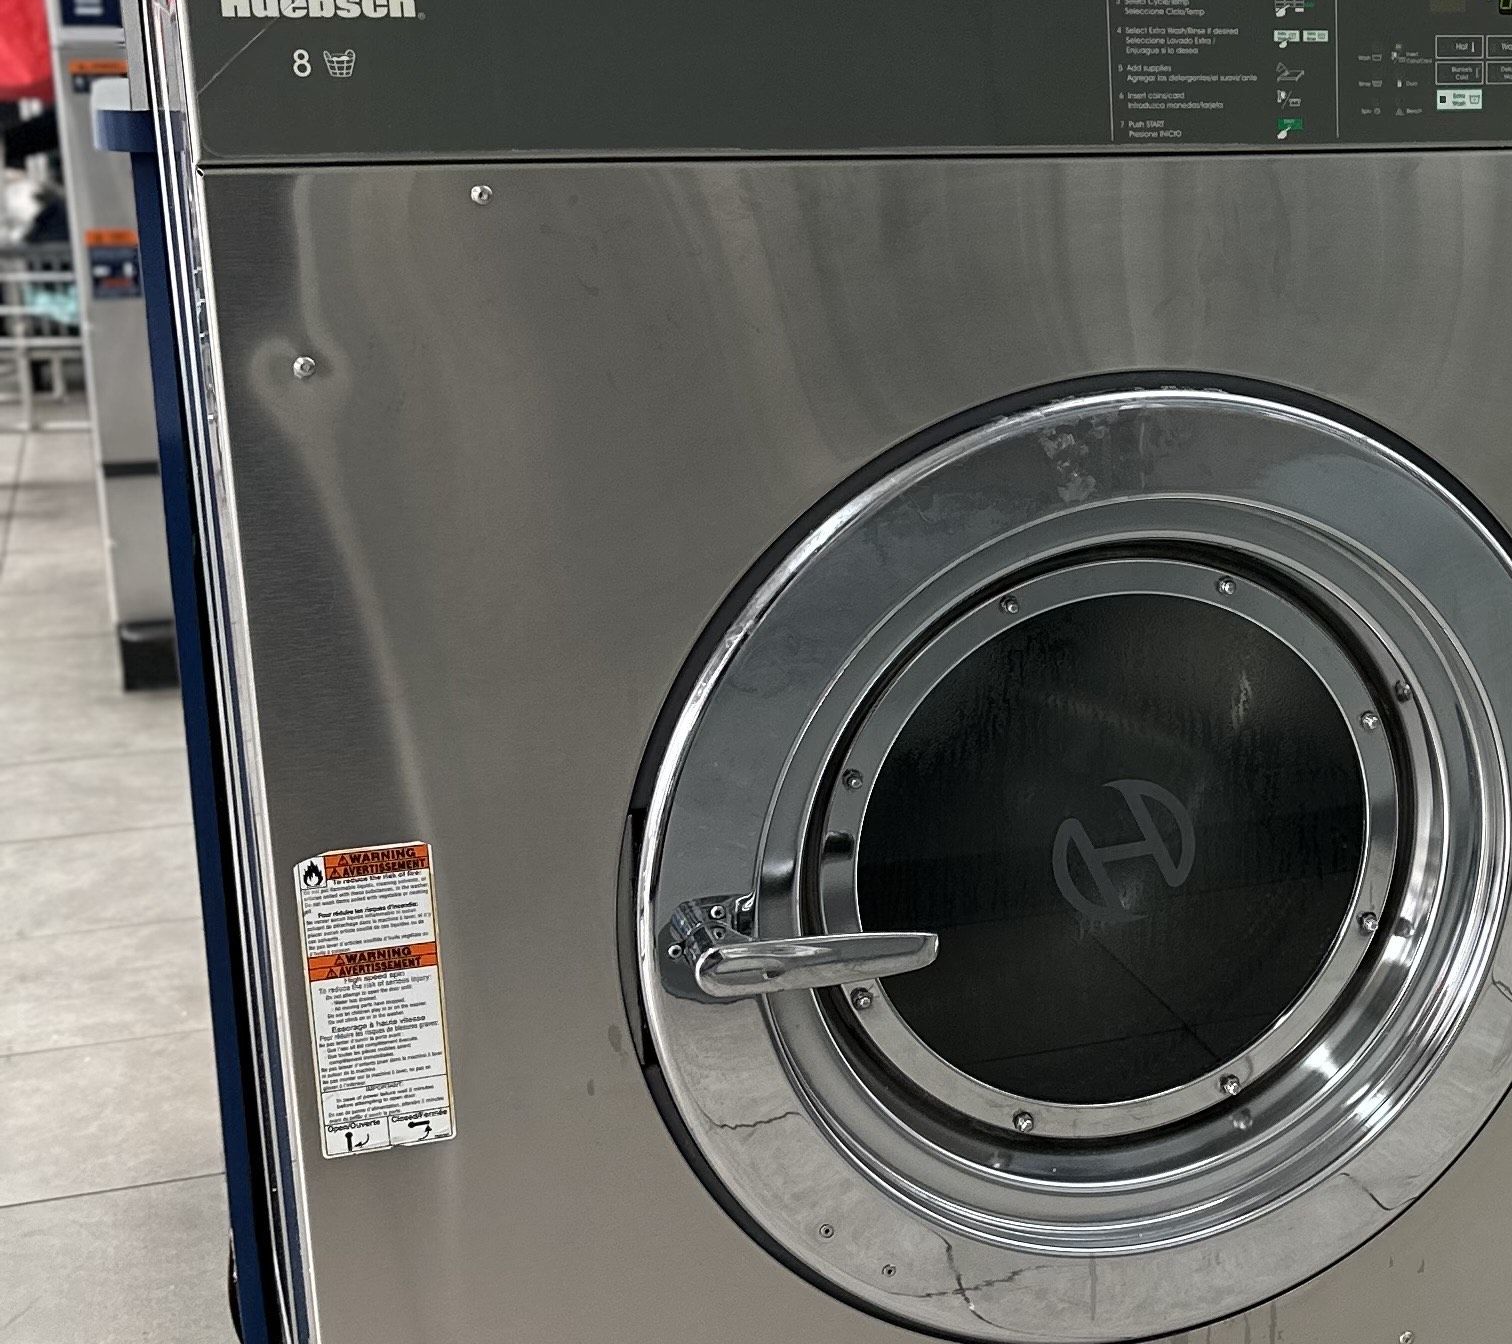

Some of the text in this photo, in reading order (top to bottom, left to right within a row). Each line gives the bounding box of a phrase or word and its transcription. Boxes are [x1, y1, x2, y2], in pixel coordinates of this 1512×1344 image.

[293, 49, 311, 77] 8
[350, 848, 415, 863] WARNING
[345, 947, 411, 963] WARNING
[339, 957, 420, 975] AVERTISSEMENT
